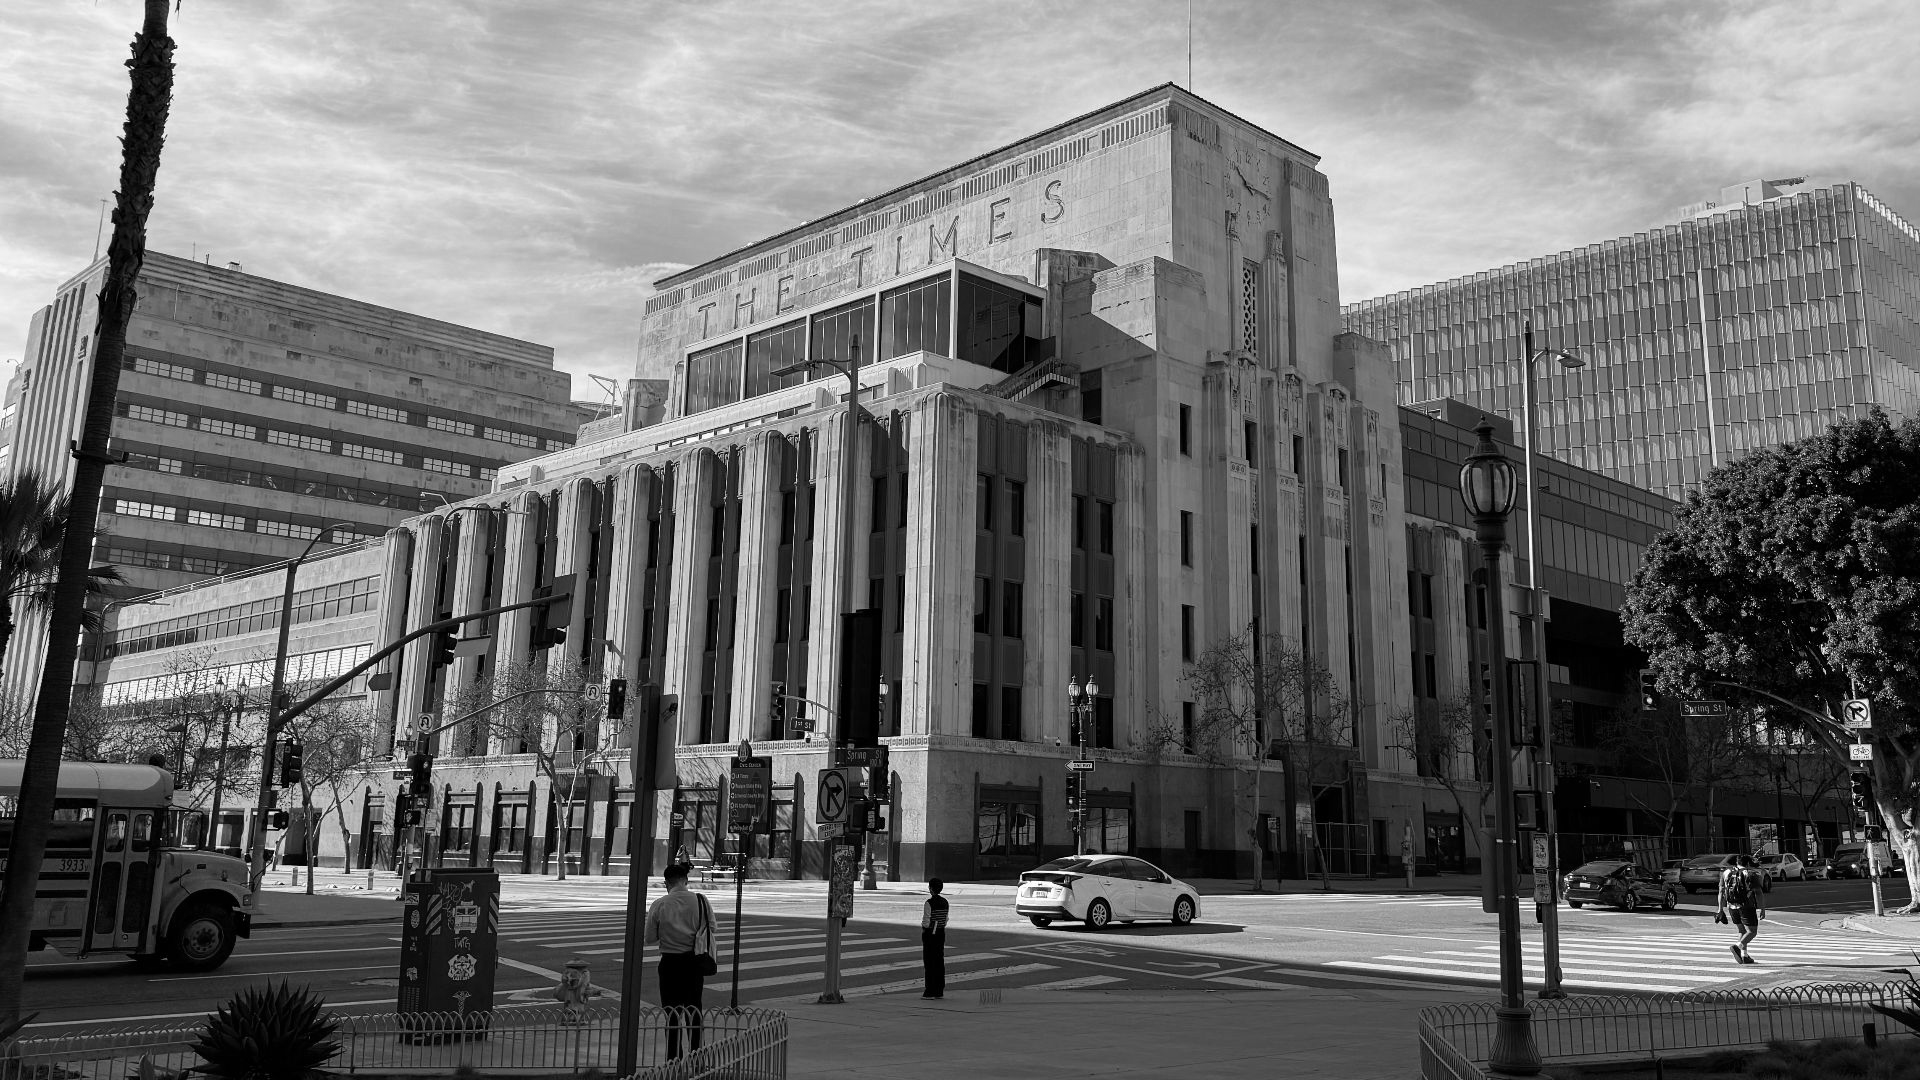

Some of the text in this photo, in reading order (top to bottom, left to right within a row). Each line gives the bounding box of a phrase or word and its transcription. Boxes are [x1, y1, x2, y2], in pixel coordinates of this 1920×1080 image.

[697, 179, 1065, 339] THE TIMES
[1684, 703, 1722, 715] Spring St
[847, 749, 883, 762] Spring St
